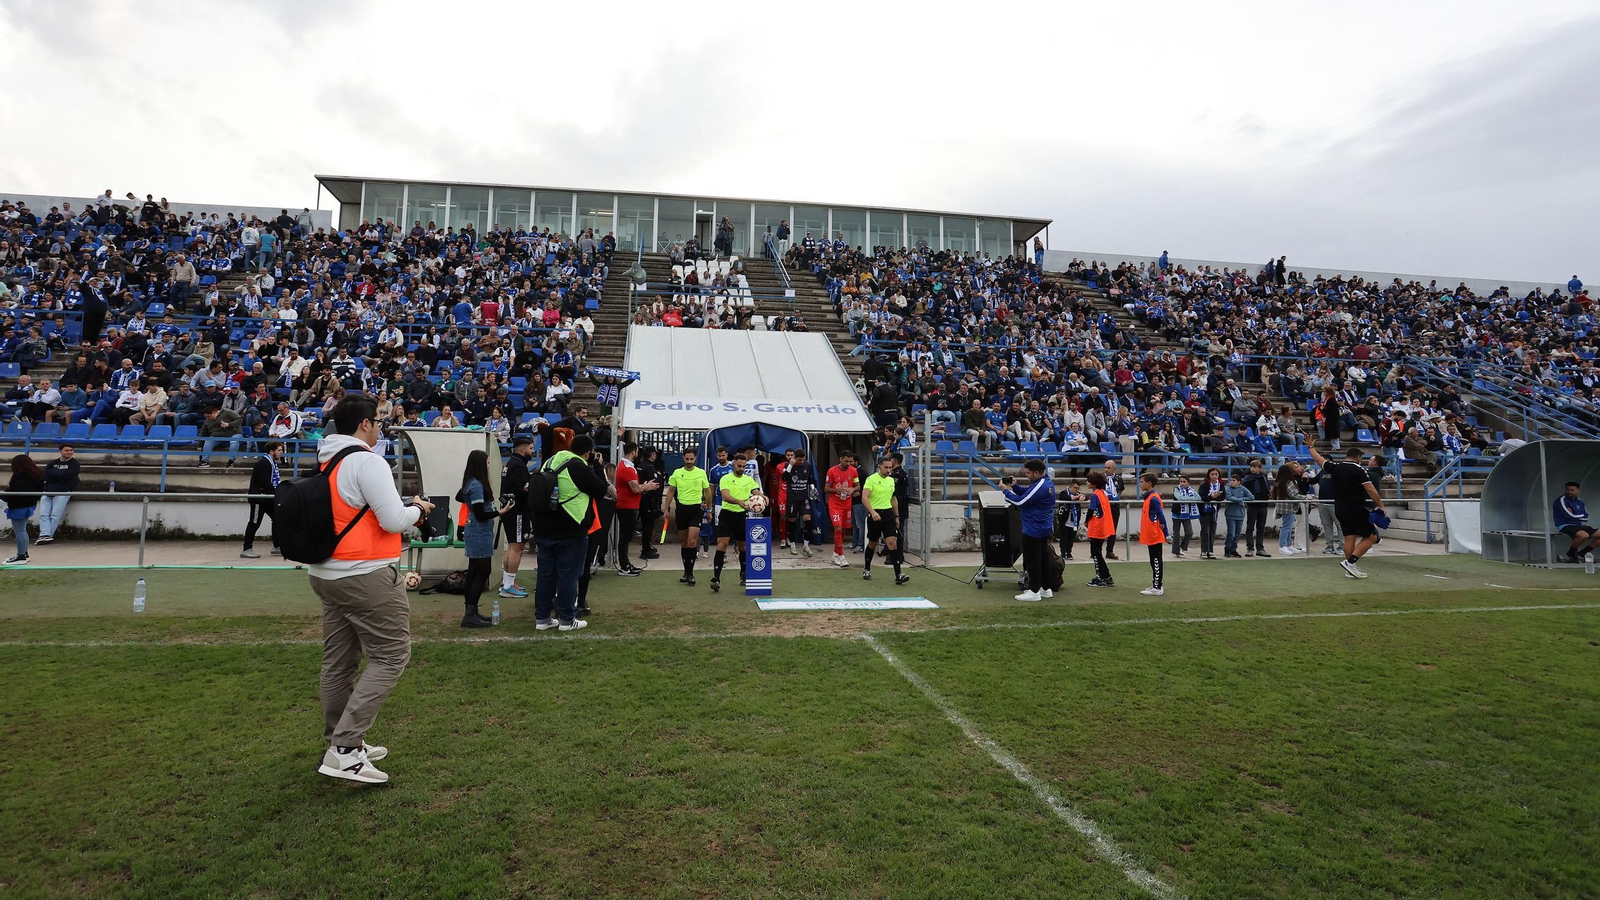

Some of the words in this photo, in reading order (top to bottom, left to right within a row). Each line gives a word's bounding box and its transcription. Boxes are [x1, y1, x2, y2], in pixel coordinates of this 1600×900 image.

[635, 400, 713, 411] Pedro
[722, 402, 747, 412] S.
[753, 403, 857, 415] Garrido
